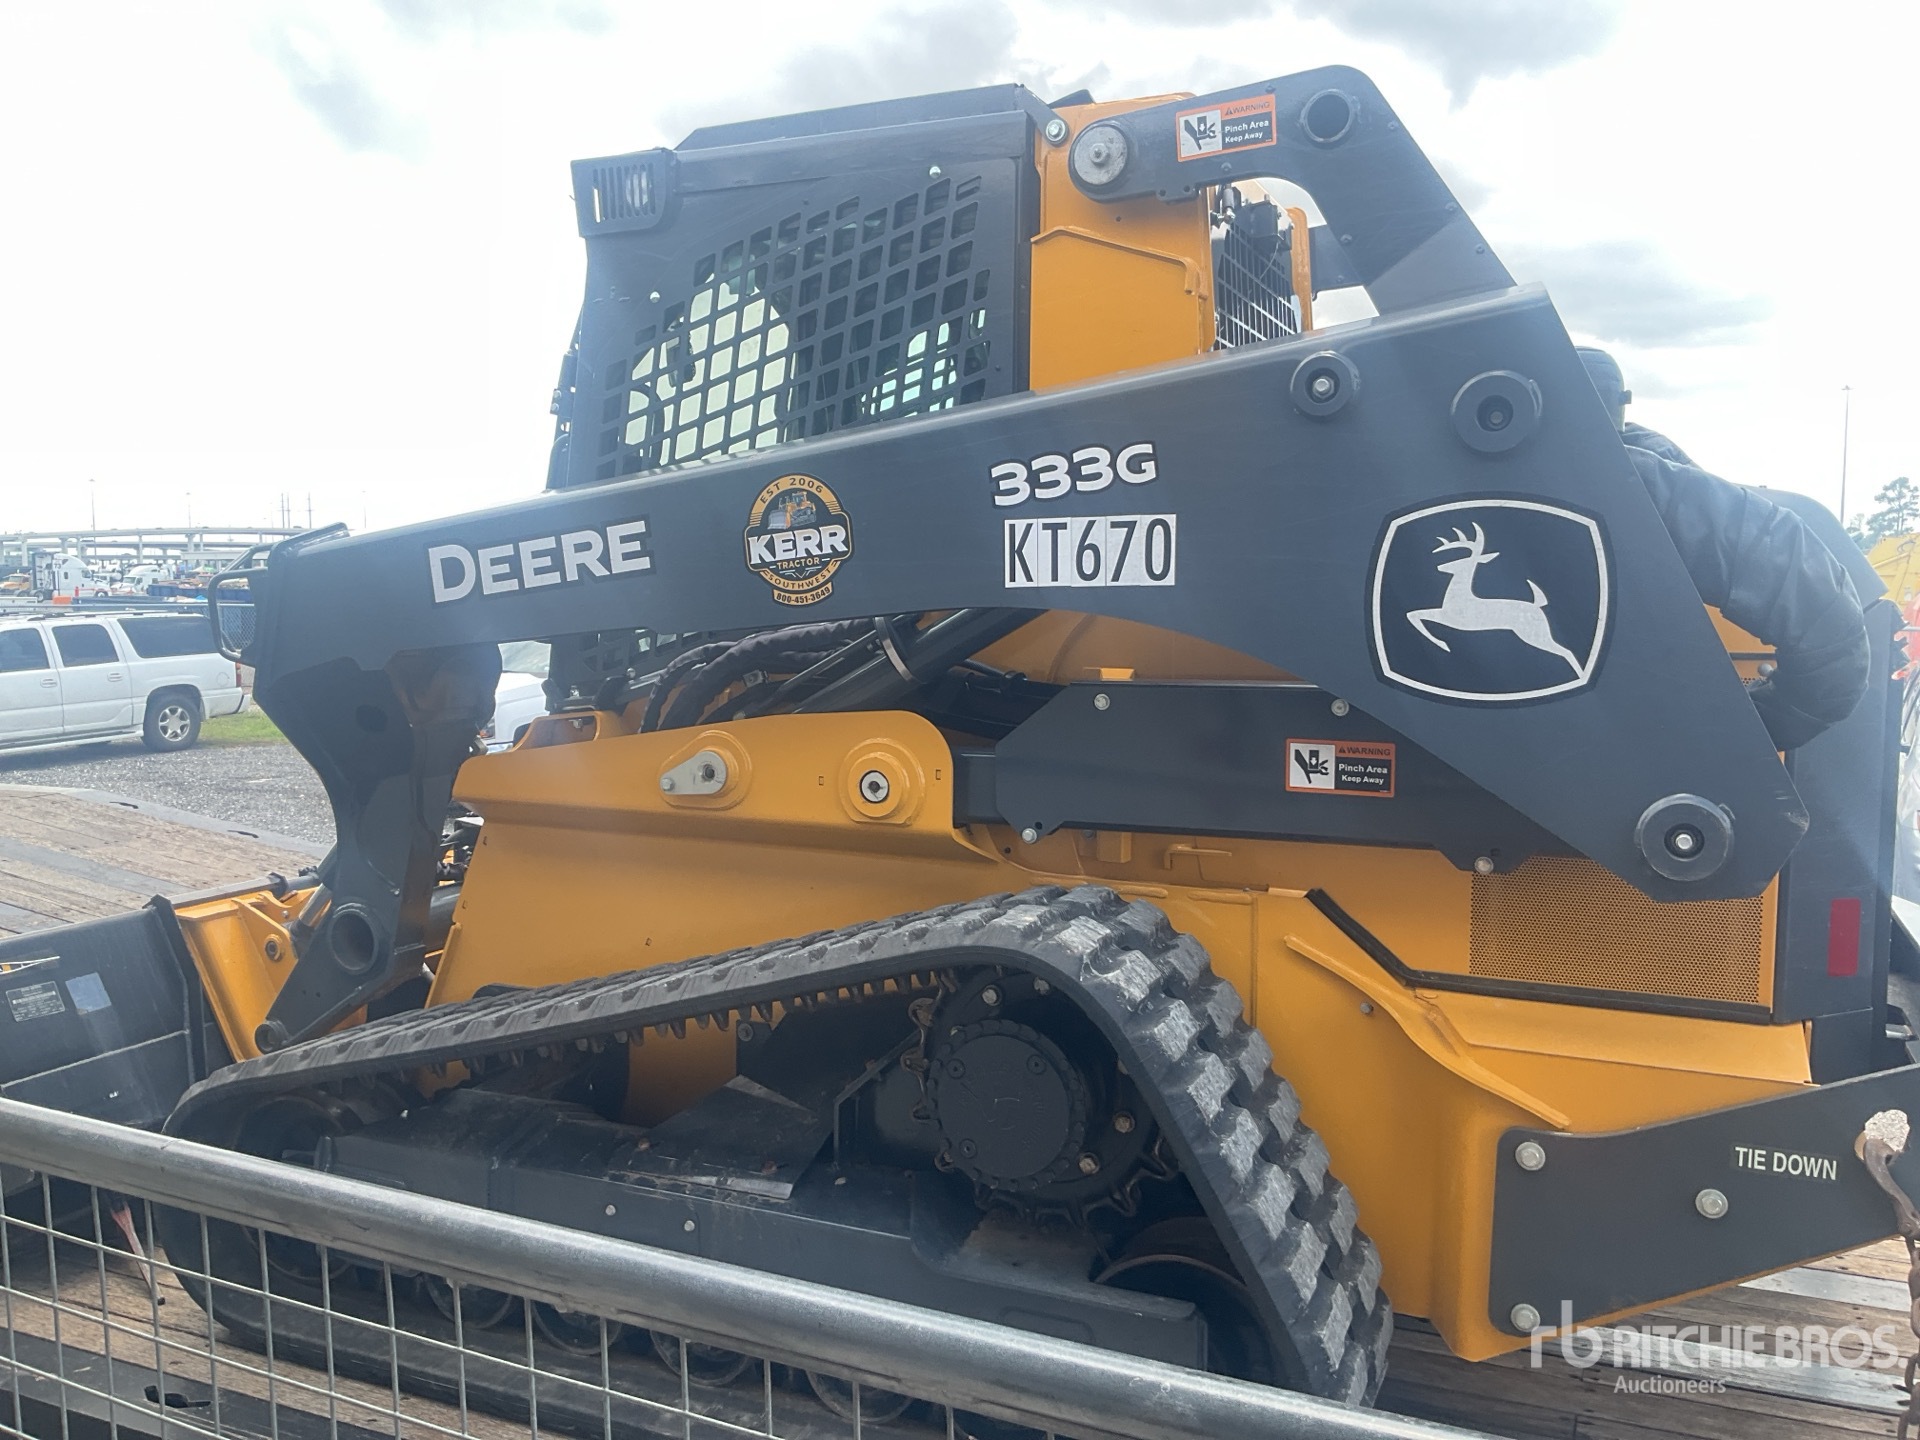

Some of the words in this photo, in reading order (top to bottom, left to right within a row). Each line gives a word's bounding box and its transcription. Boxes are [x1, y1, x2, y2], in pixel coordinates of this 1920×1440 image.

[1232, 101, 1270, 114] WARNING
[1224, 122, 1248, 133] Pinch
[1249, 120, 1269, 128] Area
[1225, 135, 1243, 143] Keep
[1244, 131, 1263, 140] Away
[990, 443, 1157, 506] 333G
[760, 482, 781, 504] EST
[789, 477, 824, 493] 2006
[748, 524, 849, 564] KERR
[1008, 517, 1172, 583] KT670
[428, 520, 651, 603] DEERE
[777, 556, 820, 570] TRACTOR
[768, 568, 832, 590] SOUTHWEST
[1346, 746, 1391, 756] WARNING
[1338, 763, 1364, 772] Pinch
[1366, 765, 1388, 774] Area
[1341, 775, 1362, 783] Keep
[1363, 777, 1384, 785] Away
[1735, 1146, 1767, 1171] TIE
[1773, 1151, 1837, 1180] DOWN
